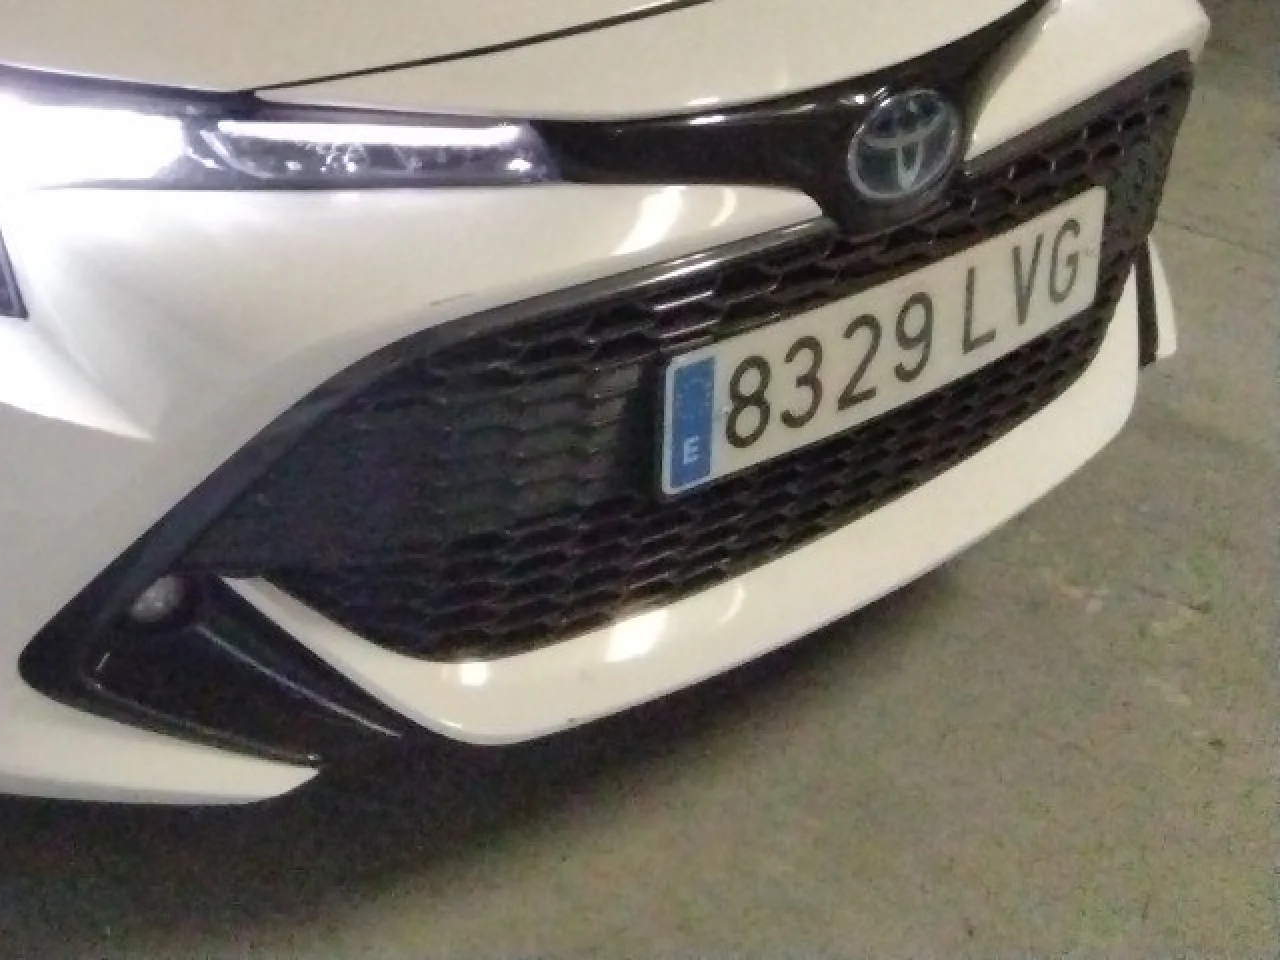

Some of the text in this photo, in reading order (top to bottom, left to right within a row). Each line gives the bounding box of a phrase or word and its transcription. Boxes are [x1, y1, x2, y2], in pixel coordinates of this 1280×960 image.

[724, 217, 1081, 449] 8329 LVG
[682, 436, 699, 465] E
